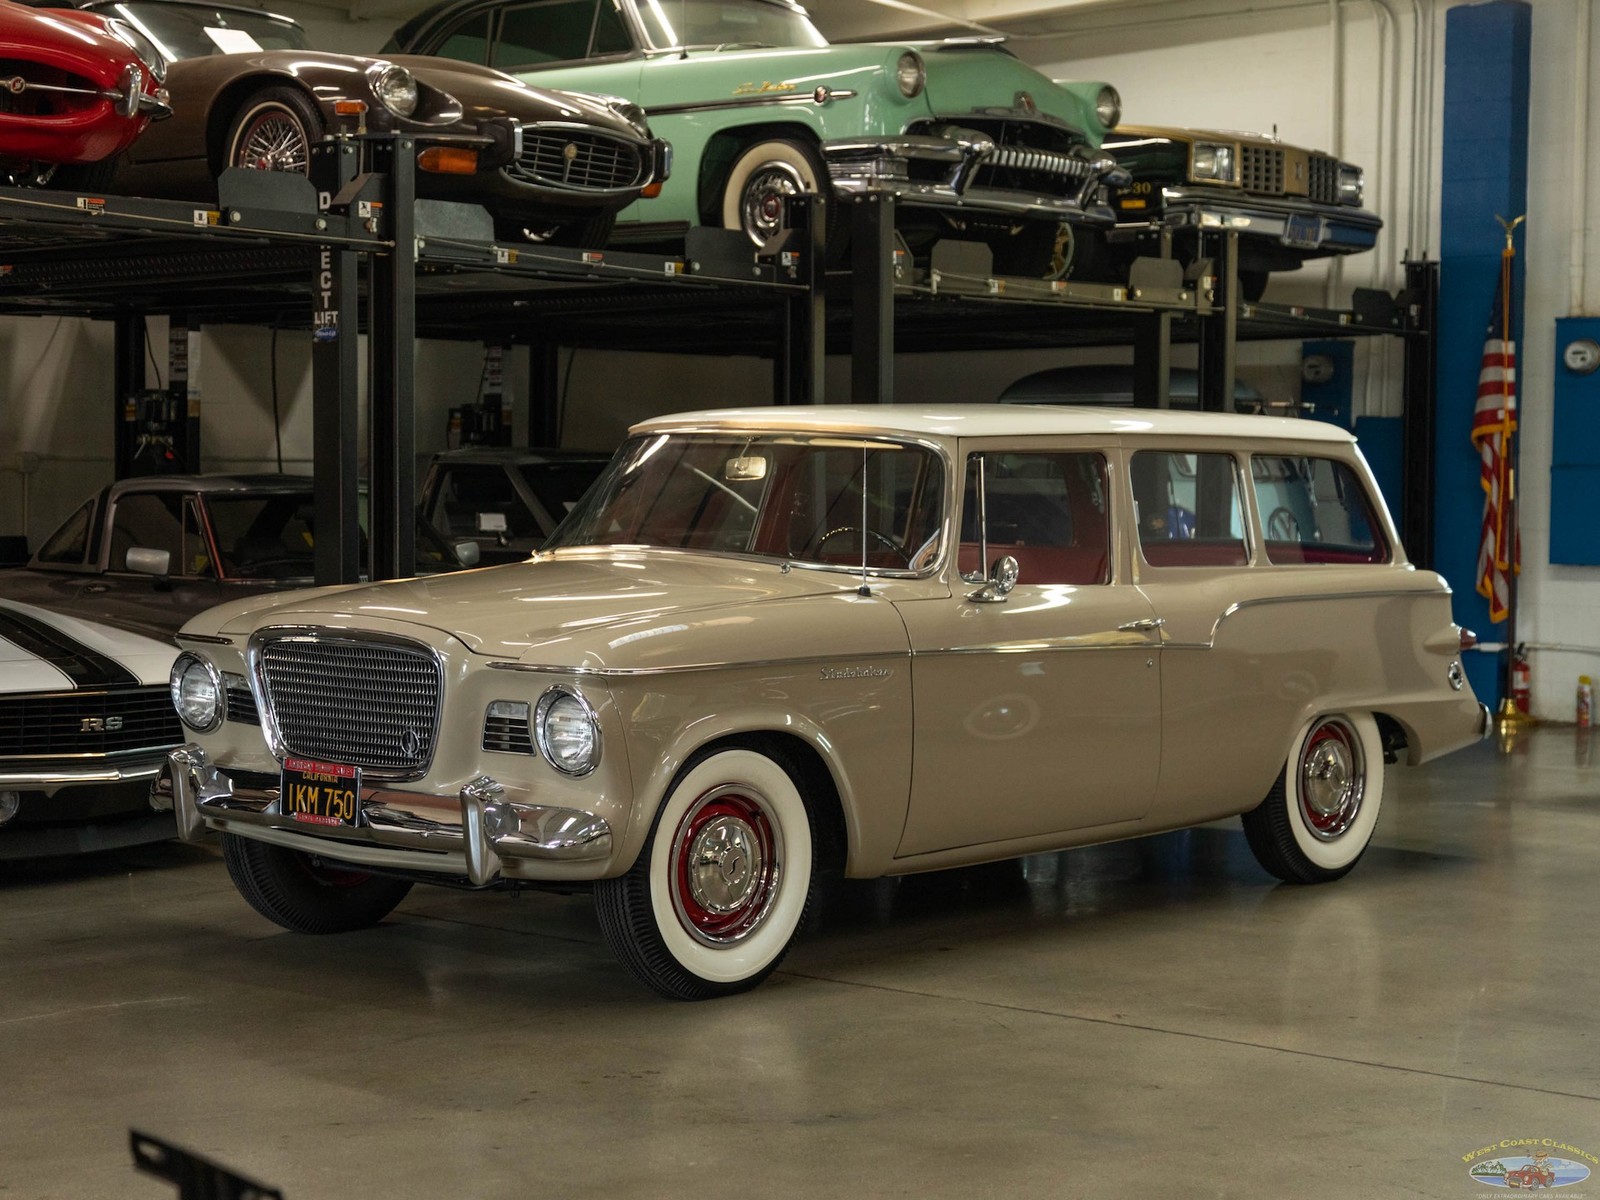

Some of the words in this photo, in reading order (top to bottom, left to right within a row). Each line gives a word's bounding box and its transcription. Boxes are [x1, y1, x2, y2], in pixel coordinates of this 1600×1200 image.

[319, 192, 332, 309] DECT
[314, 311, 338, 324] LIFT
[80, 716, 123, 732] RS
[303, 772, 338, 783] CALIFORNIA
[324, 788, 354, 820] 750
